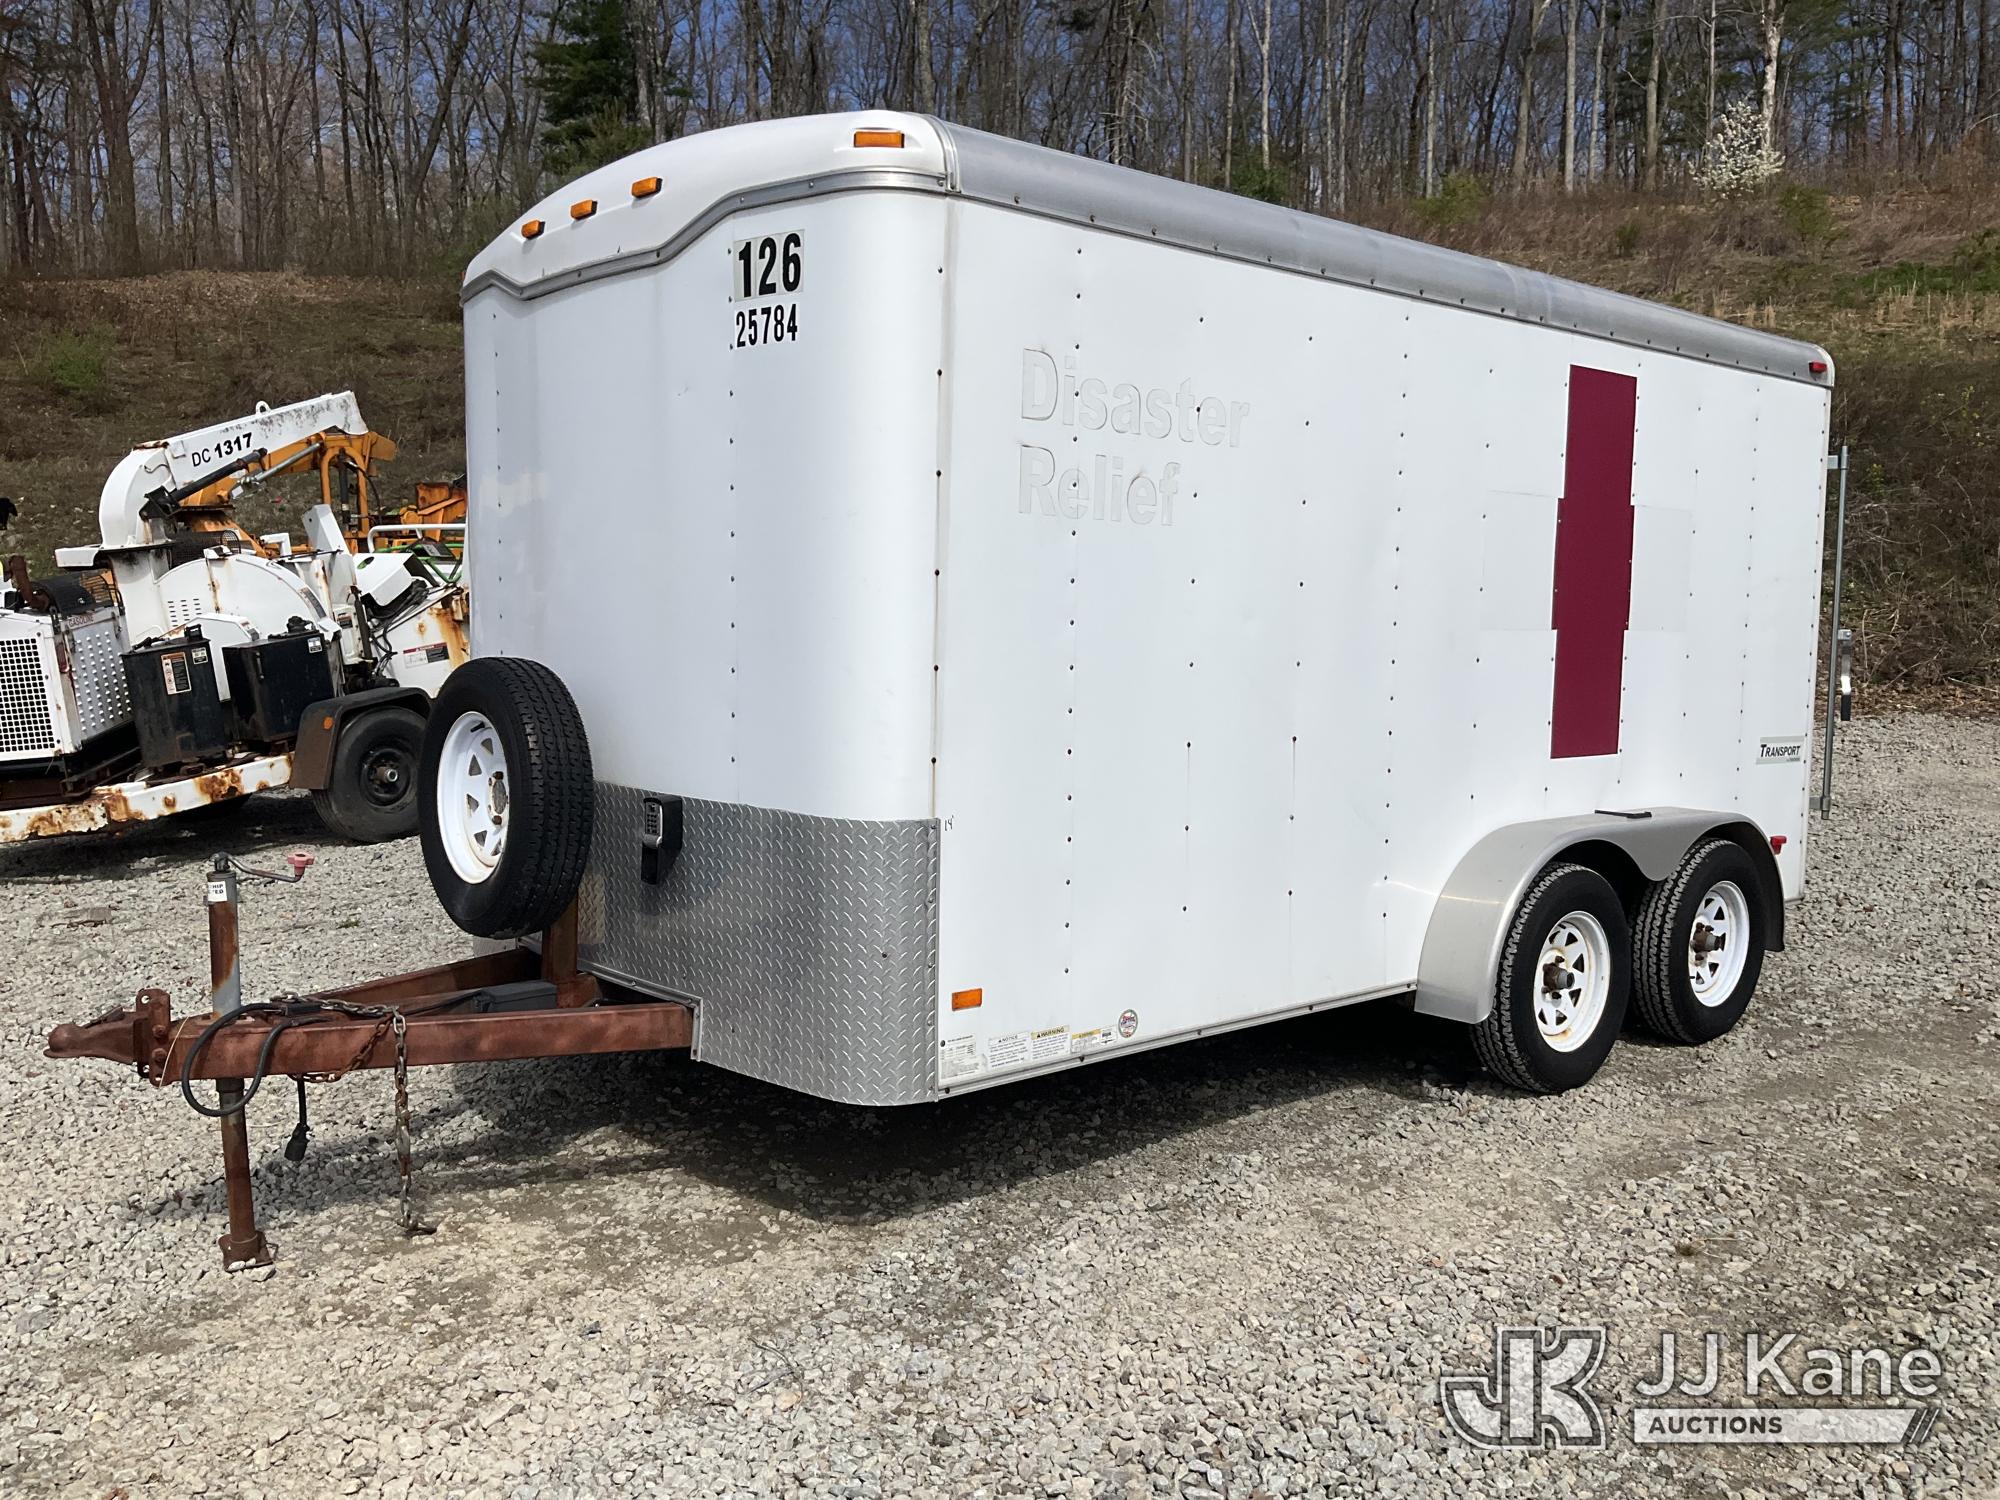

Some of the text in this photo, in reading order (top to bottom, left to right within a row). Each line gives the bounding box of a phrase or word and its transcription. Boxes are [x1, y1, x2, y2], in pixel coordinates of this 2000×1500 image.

[738, 232, 802, 298] 126
[736, 303, 798, 348] 25784
[1021, 347, 1250, 448] Disaster
[191, 432, 252, 467] DC 1317
[1019, 444, 1181, 526] Relief
[1760, 744, 1801, 757] TRANSPORT
